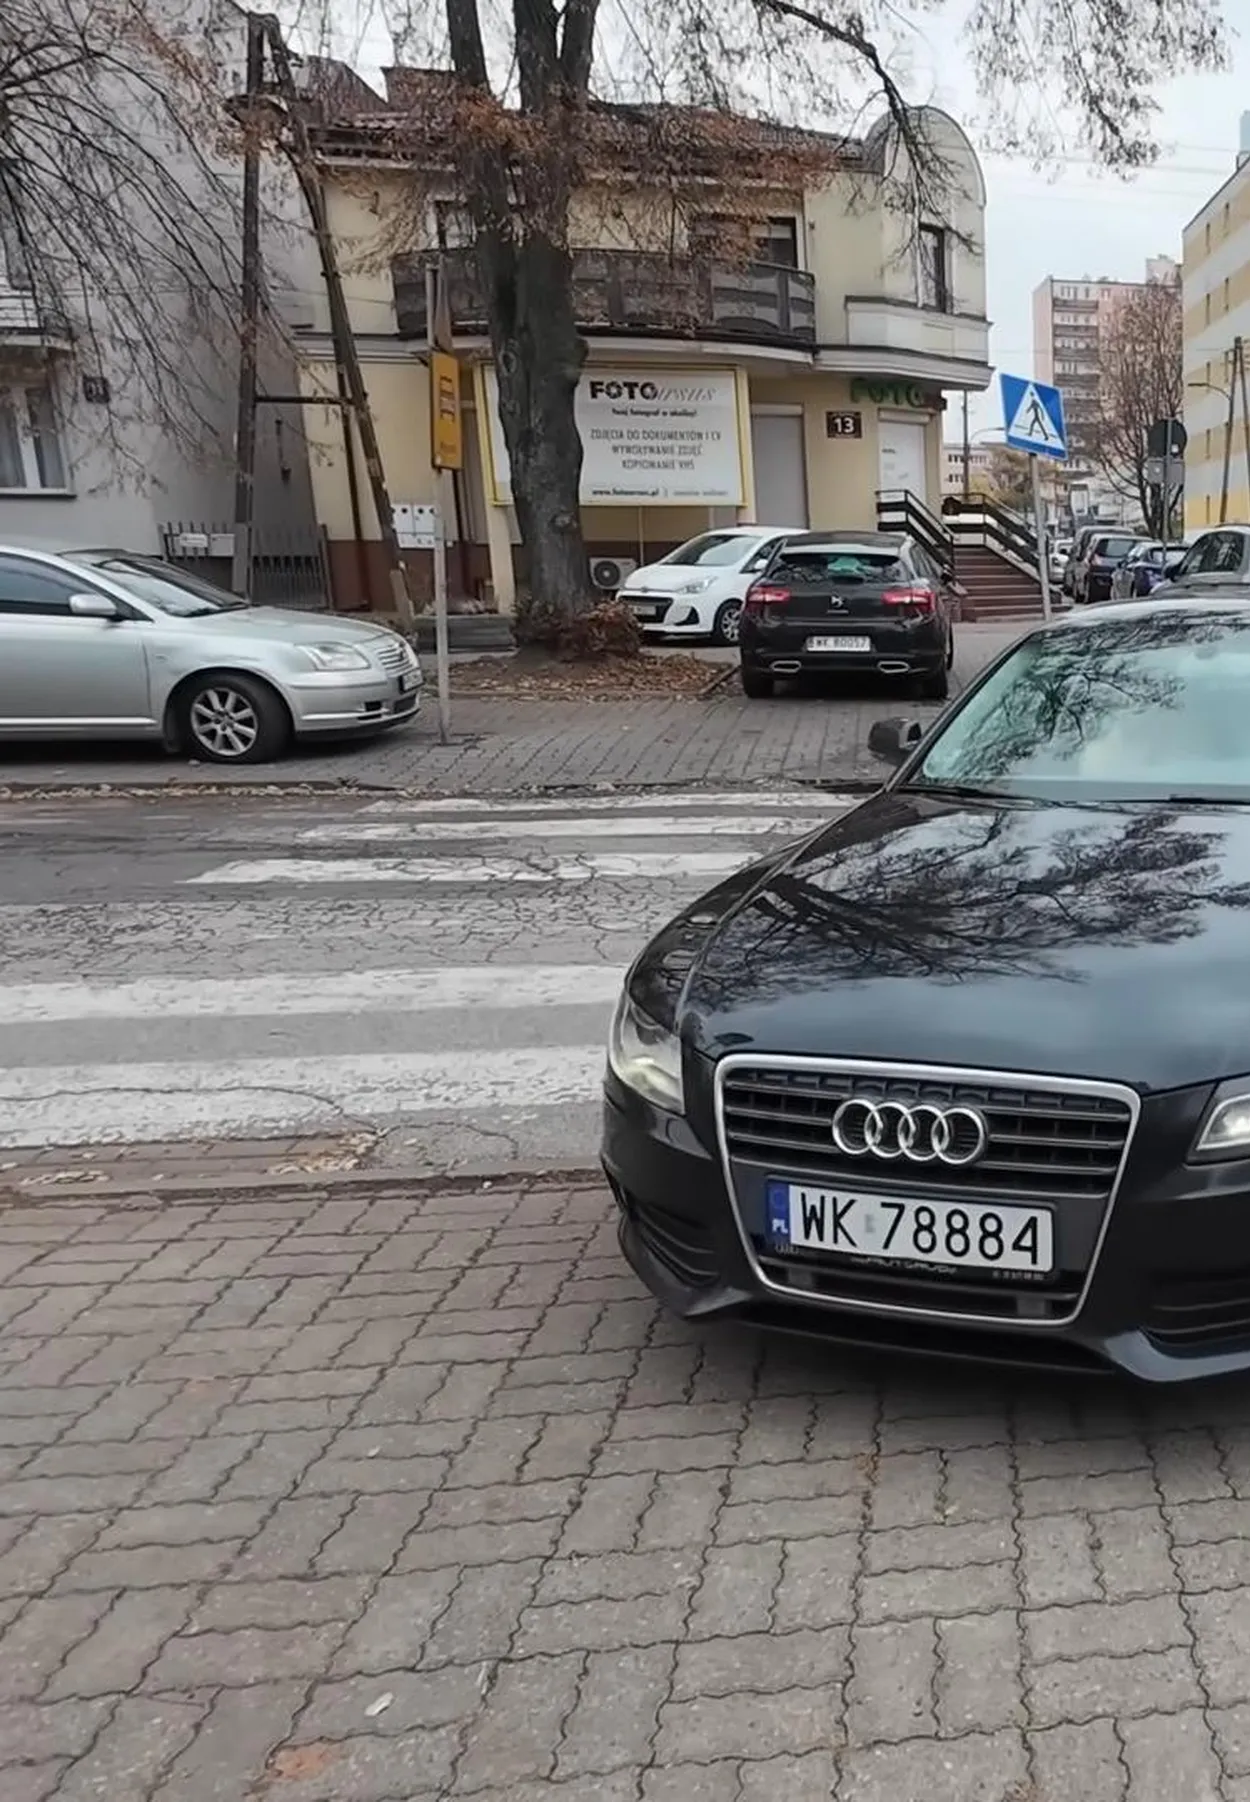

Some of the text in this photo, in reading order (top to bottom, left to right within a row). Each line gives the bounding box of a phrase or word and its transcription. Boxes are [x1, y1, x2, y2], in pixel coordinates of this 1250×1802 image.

[834, 416, 854, 433] 13
[627, 429, 640, 441] DO
[772, 1219, 789, 1235] PL
[801, 1192, 1039, 1266] WK 78884
